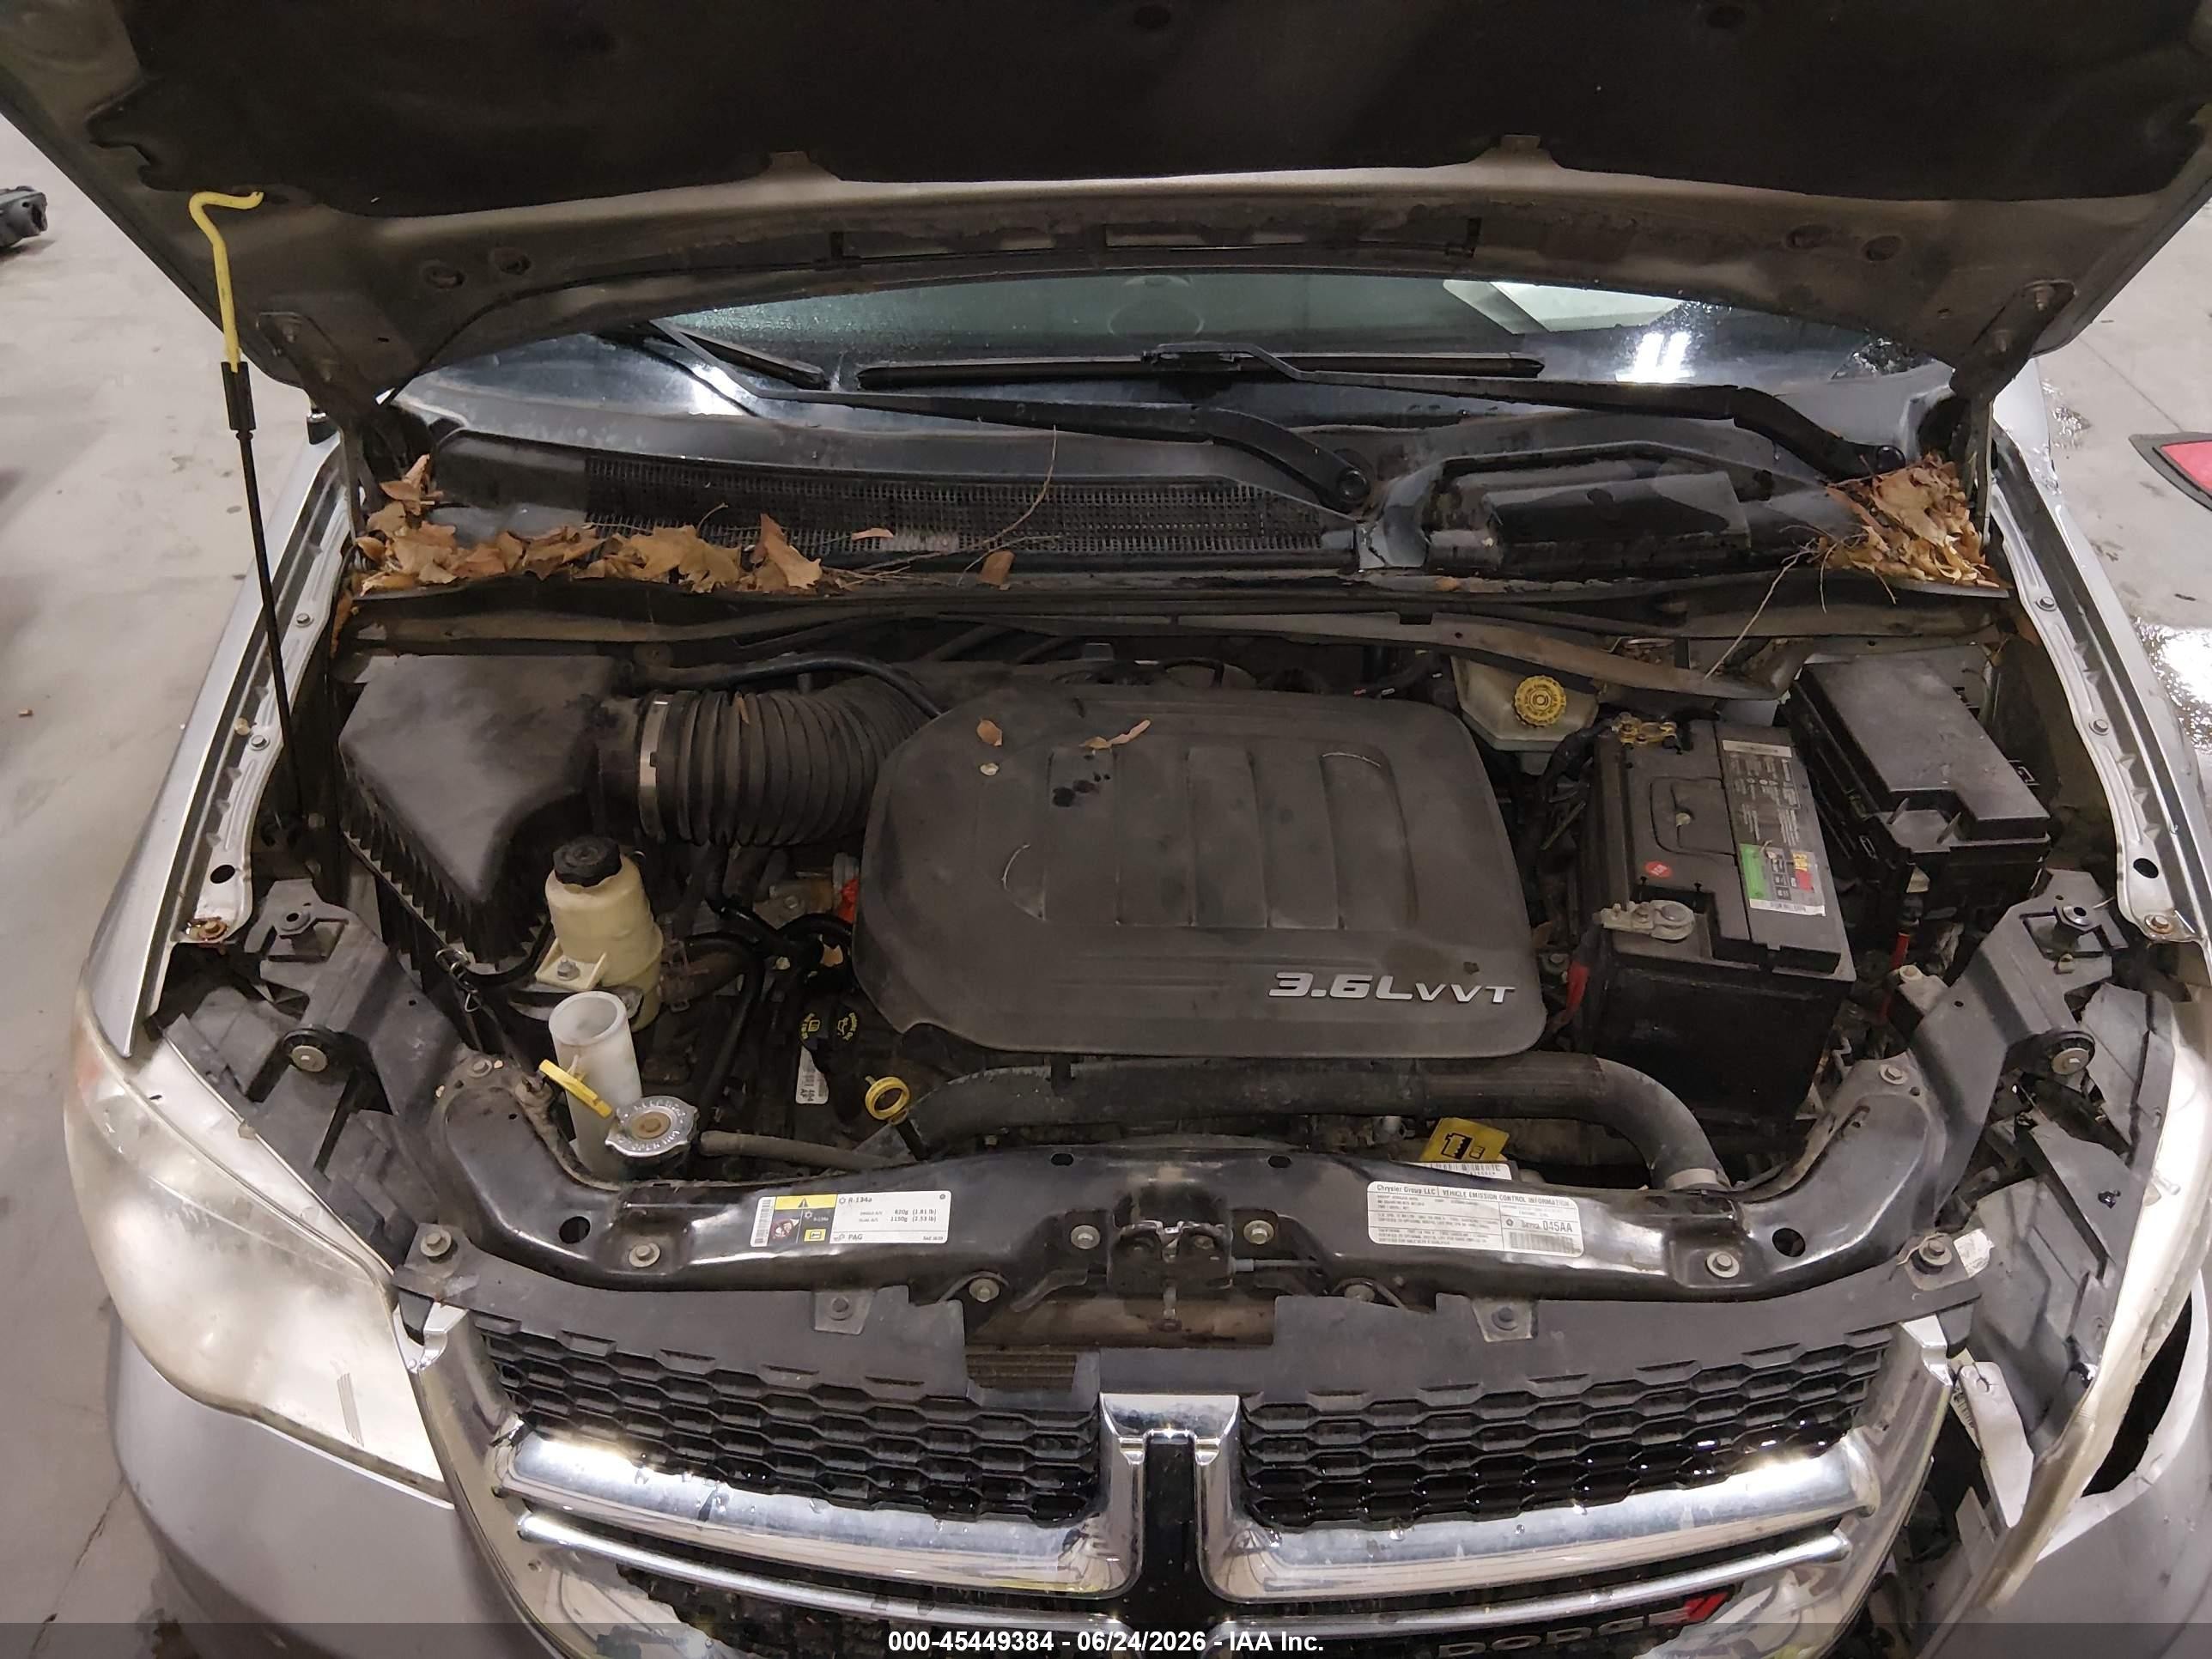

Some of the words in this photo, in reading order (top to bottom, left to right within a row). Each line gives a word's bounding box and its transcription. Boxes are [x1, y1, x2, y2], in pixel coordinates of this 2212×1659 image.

[1443, 1189, 1467, 1199] VEHICLE
[1468, 1192, 1498, 1201] EMISSION
[1498, 1194, 1527, 1203] CONTROL
